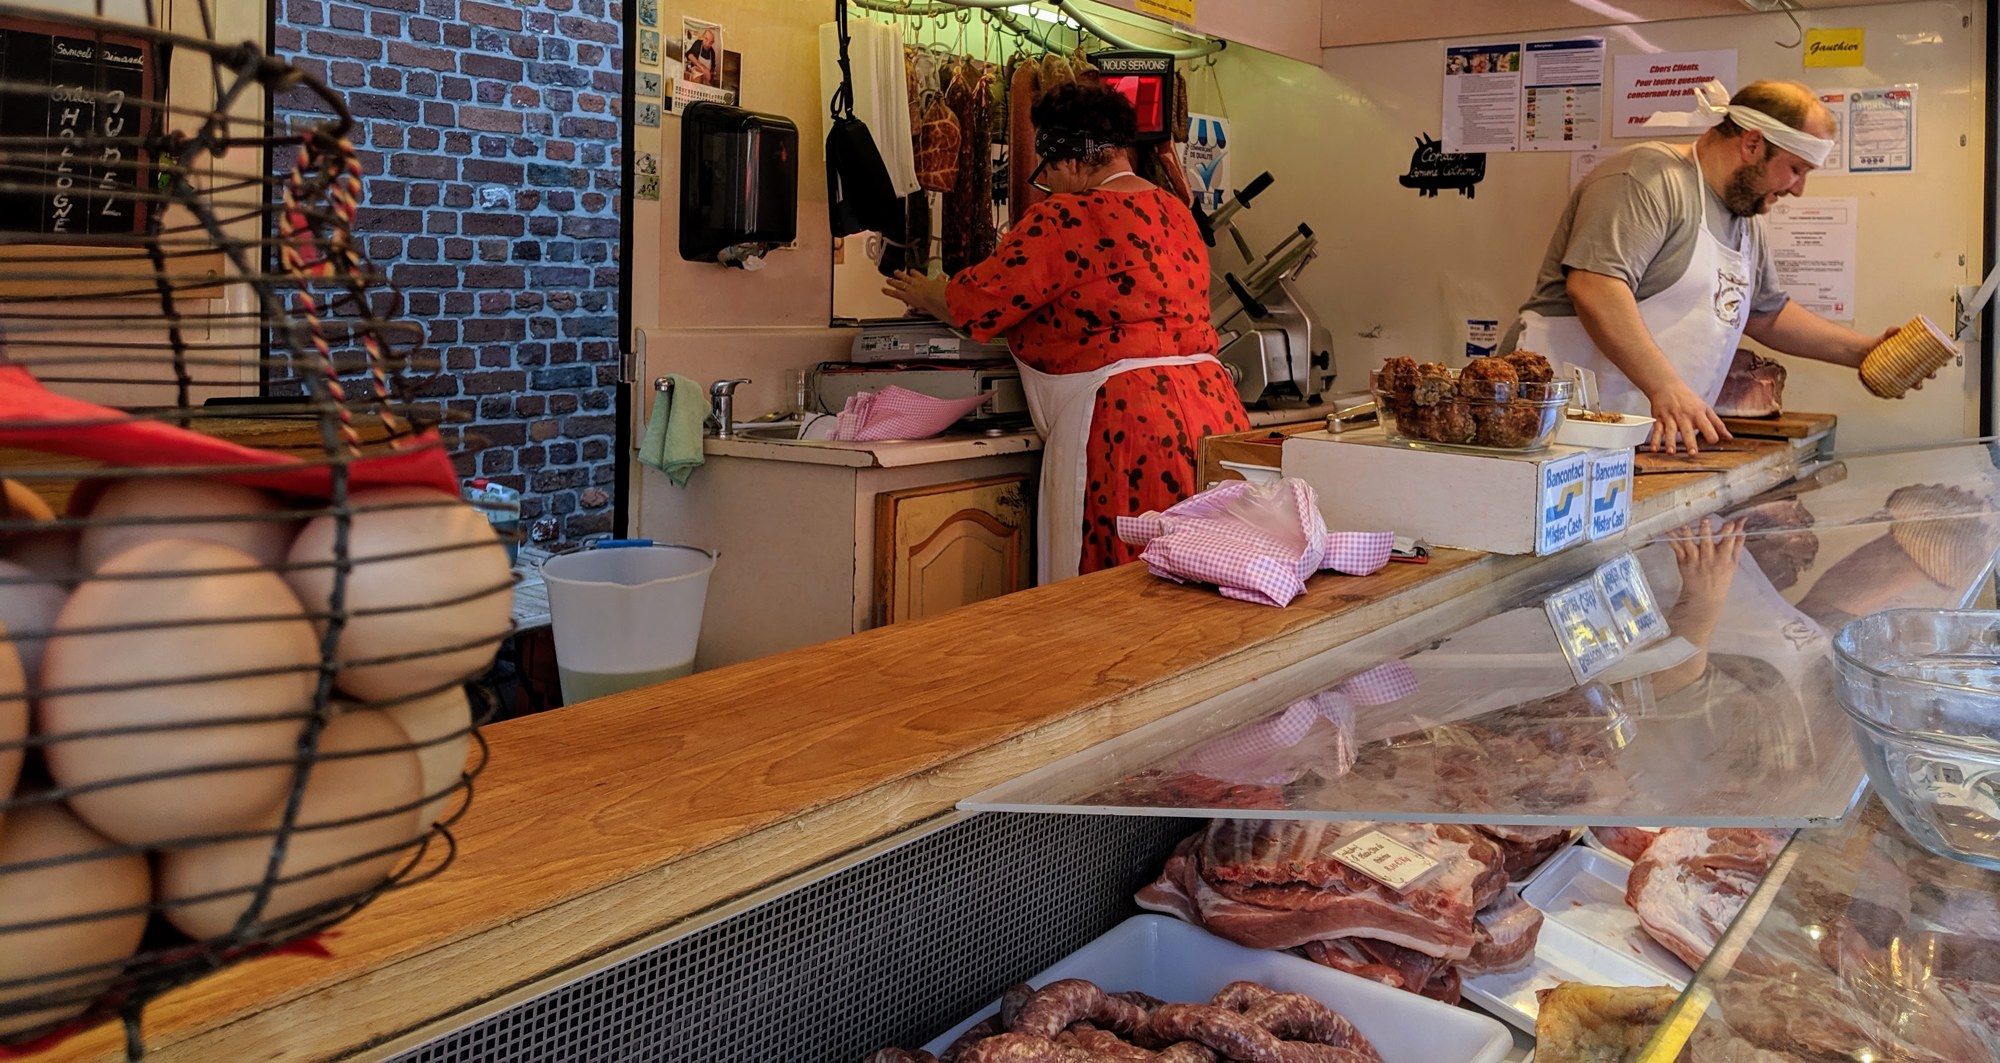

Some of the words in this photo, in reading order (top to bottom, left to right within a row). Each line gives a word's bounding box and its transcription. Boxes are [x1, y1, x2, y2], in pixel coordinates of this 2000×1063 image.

[56, 43, 95, 59] Samedi
[1810, 41, 1858, 55] Gauthier
[1103, 60, 1127, 71] NOUS
[1128, 60, 1166, 71] SERVONS
[1650, 65, 1671, 73] Chers
[1635, 79, 1652, 87] Pour
[1653, 77, 1677, 86] toutes
[1627, 89, 1669, 99] concernant
[1669, 88, 1682, 97] les
[1546, 460, 1584, 489] Bancontact
[1595, 460, 1627, 481] Bancontact
[1593, 516, 1611, 535] Mister
[1611, 509, 1624, 528] Cash
[1545, 525, 1566, 547] Mister
[1567, 514, 1583, 536] Cash
